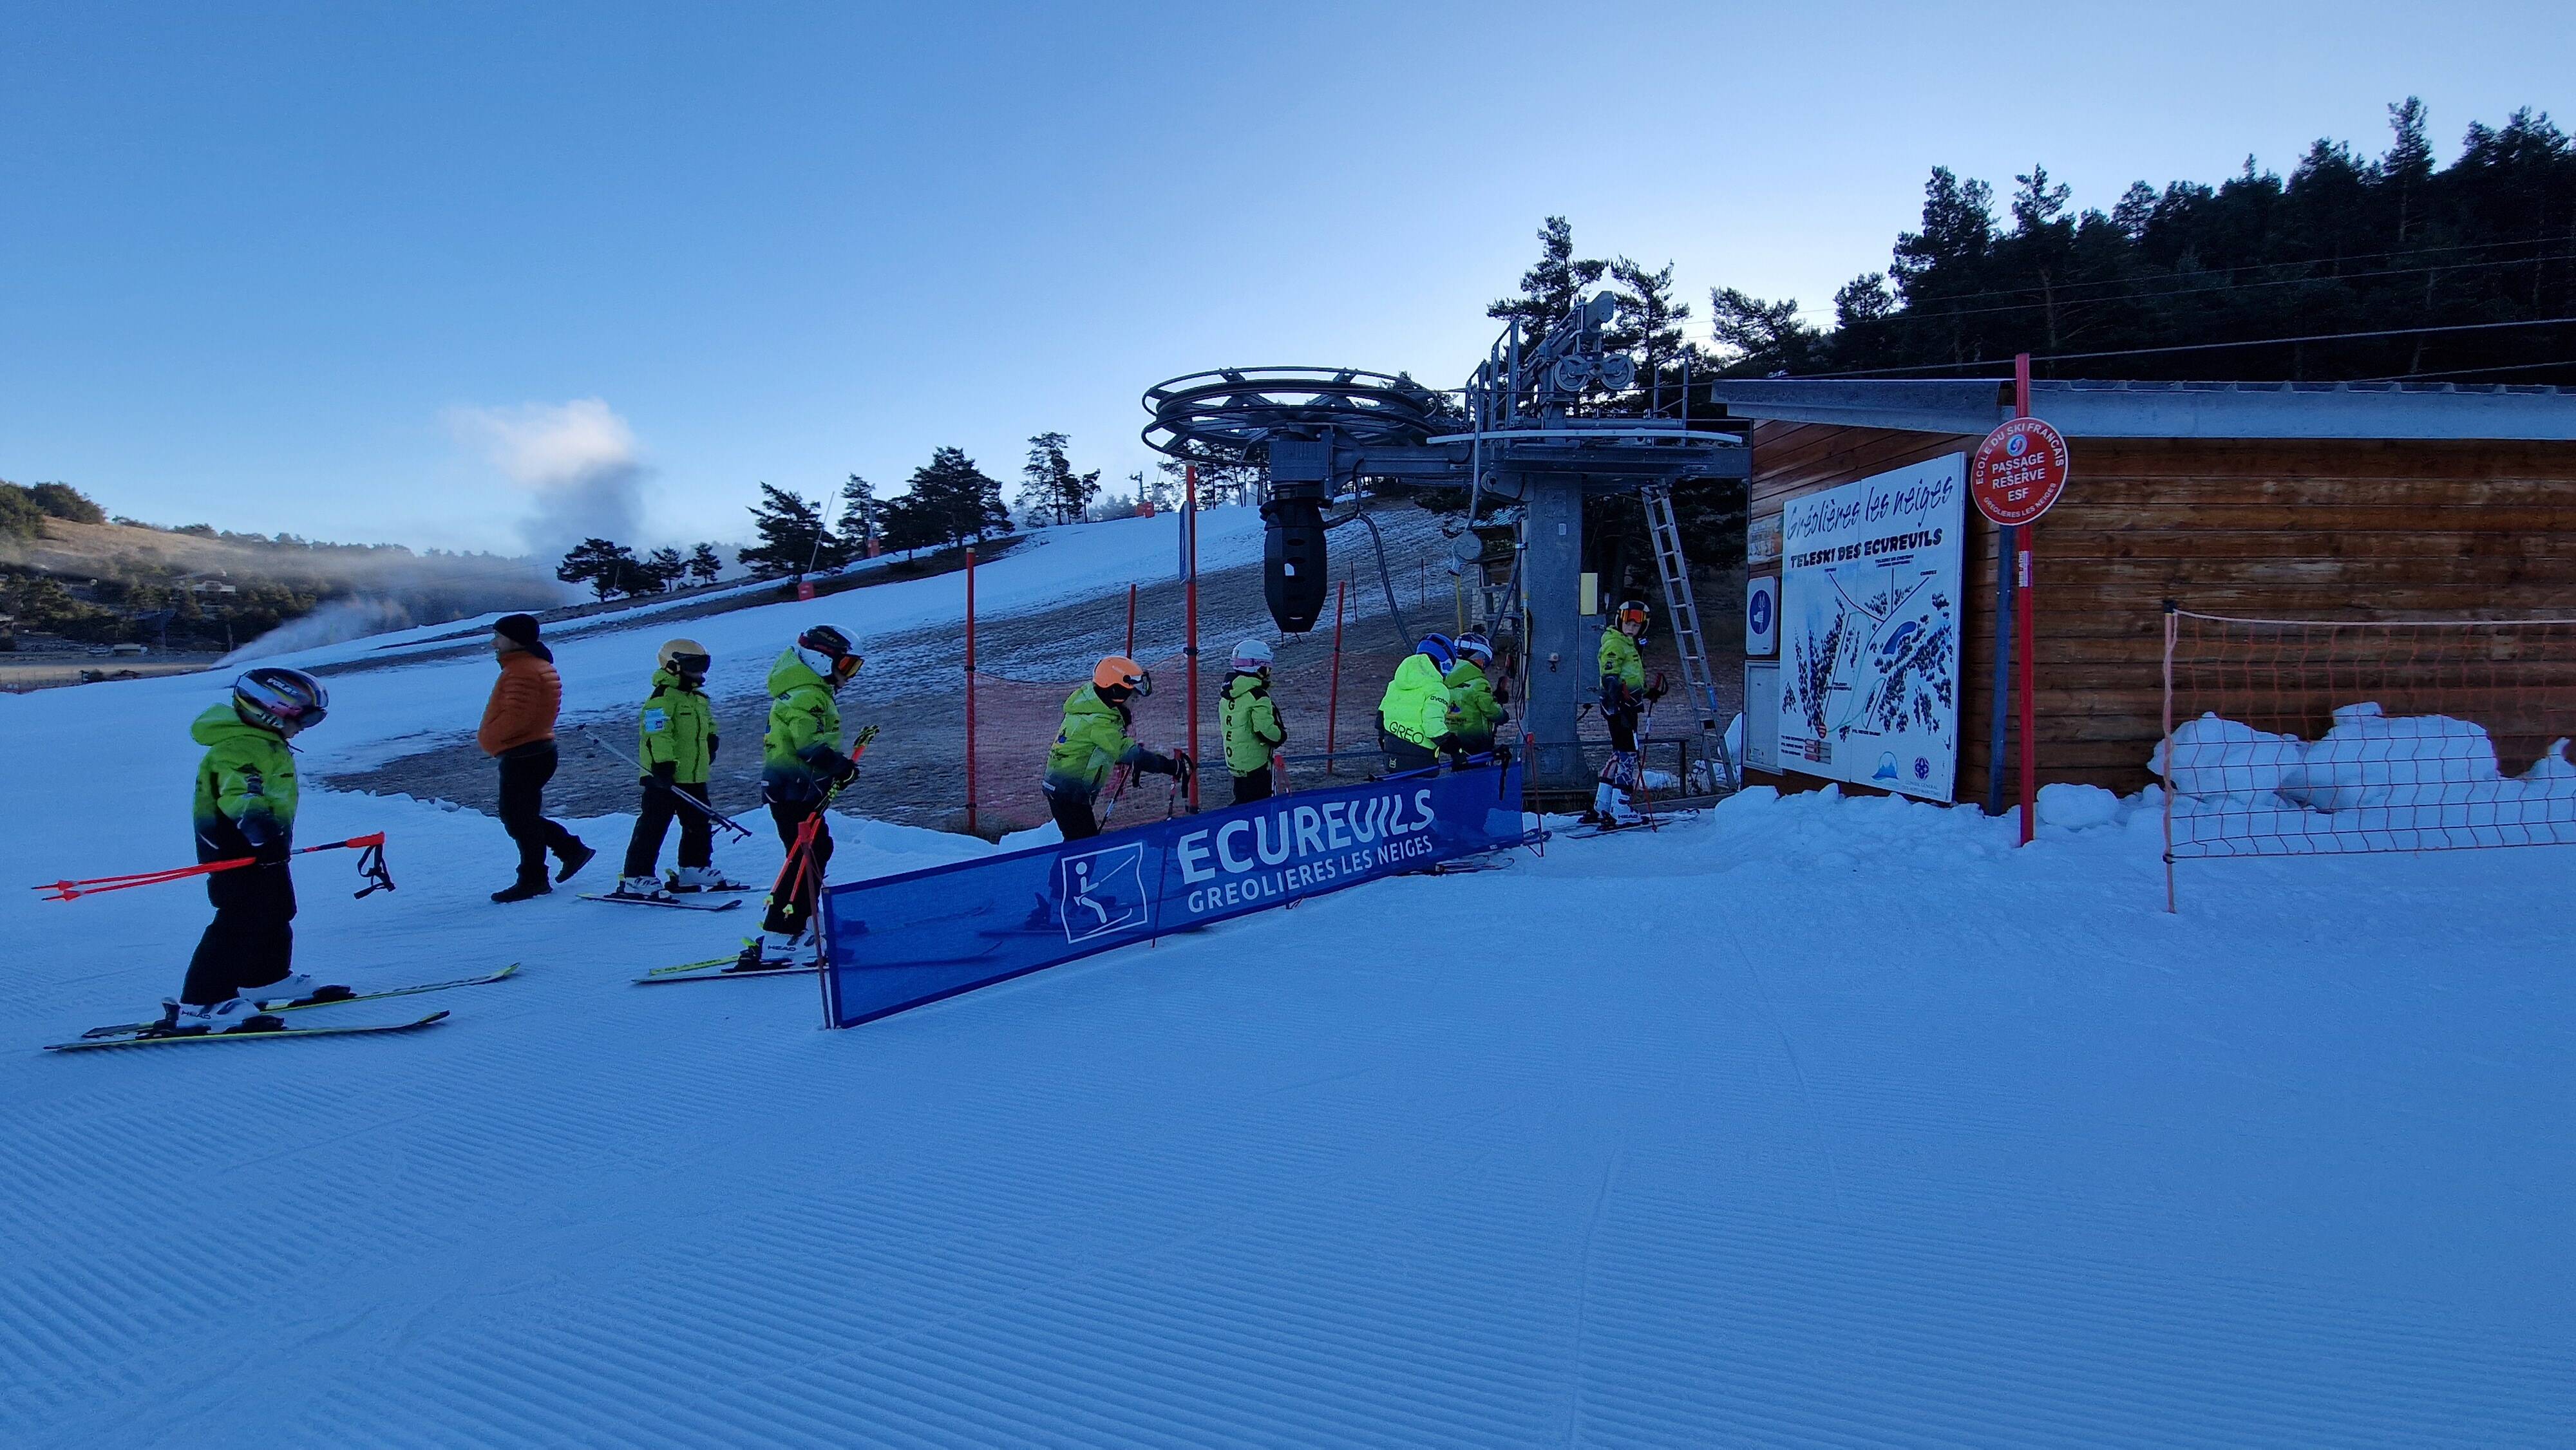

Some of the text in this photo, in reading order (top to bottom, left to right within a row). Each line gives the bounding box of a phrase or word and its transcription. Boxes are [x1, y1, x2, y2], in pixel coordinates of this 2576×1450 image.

[1976, 447, 1992, 485] ECOLE
[1991, 432, 2005, 447] DU
[2007, 423, 2025, 435] SKI
[1992, 452, 2045, 475] PASSAGE
[1992, 468, 2045, 489] RESERVE
[2008, 487, 2029, 502] ESF
[1787, 499, 1860, 540] Gréolières
[1866, 486, 1889, 522] les
[1893, 476, 1953, 528] neiges
[1984, 483, 2056, 518] GREOLIERES LES NEIGES
[1790, 547, 1836, 569] TELESKI
[1837, 542, 1862, 561] DES
[1864, 528, 1942, 556] ECUREUILS
[1226, 700, 1235, 758] GREO
[1390, 721, 1425, 744] GRÉO
[1177, 789, 1435, 885] ECUREUILS
[1188, 835, 1433, 913] GREOLIERES LES NEIGES
